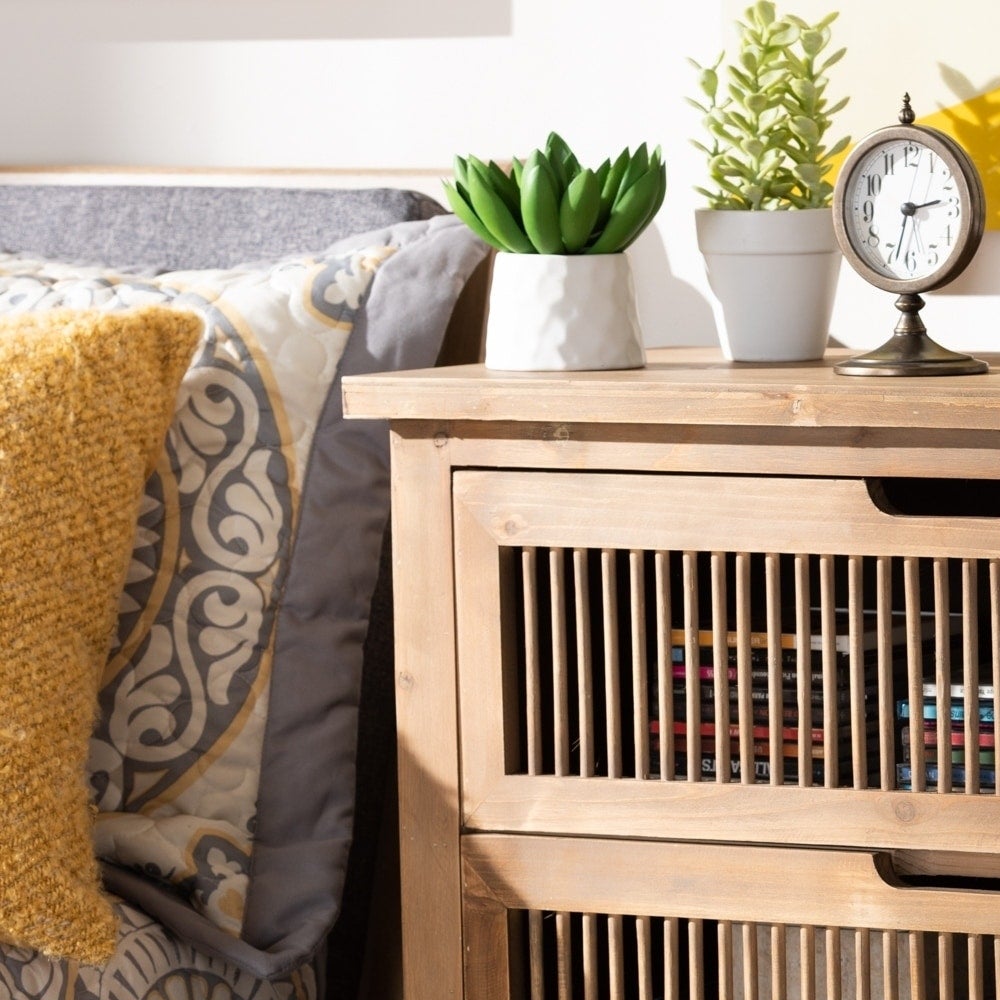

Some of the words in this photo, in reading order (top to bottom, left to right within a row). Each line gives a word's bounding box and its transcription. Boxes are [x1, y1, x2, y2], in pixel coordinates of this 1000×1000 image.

[884, 153, 895, 176] 11
[903, 146, 920, 168] 12
[929, 152, 935, 174] 1
[866, 174, 882, 197] 10
[943, 169, 955, 191] 2
[863, 200, 874, 223] 9
[948, 198, 960, 218] 3
[867, 225, 880, 248] 8
[939, 224, 954, 247] 4
[886, 242, 899, 264] 7
[904, 250, 916, 272] 6
[928, 243, 939, 266] 5
